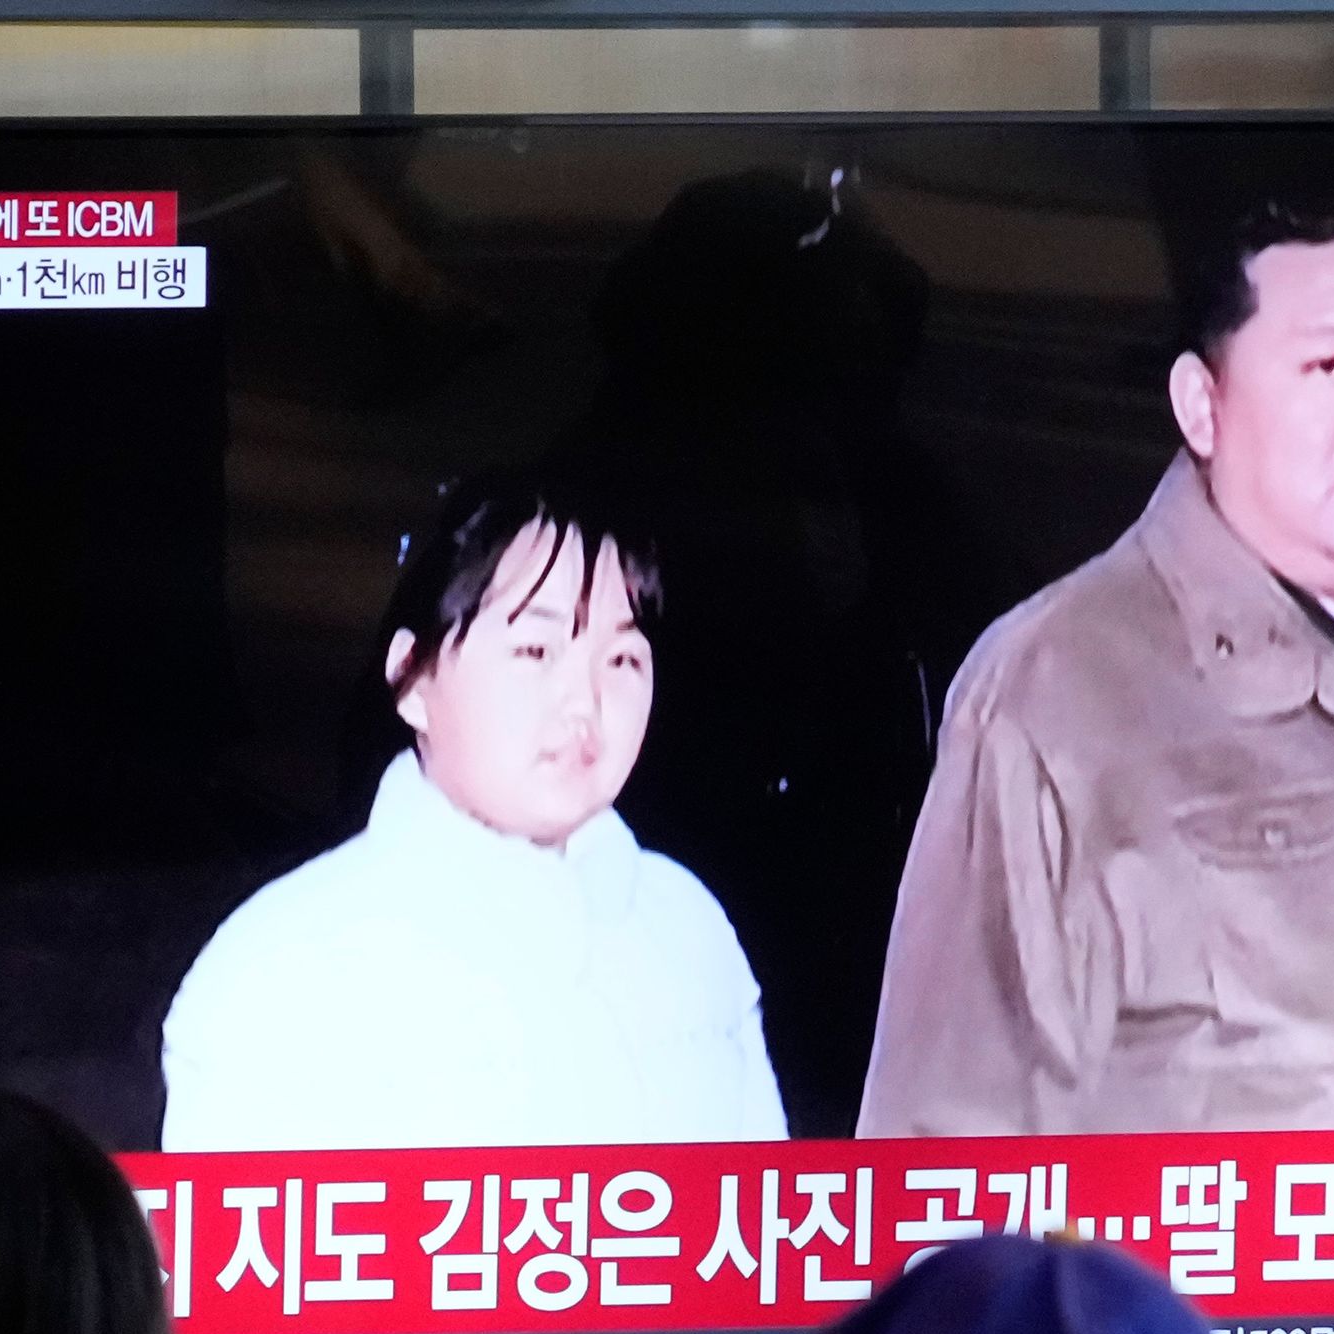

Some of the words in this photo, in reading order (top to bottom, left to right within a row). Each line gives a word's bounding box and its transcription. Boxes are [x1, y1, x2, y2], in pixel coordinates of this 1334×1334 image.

[24, 200, 62, 237] 또
[67, 200, 154, 238] ICBM
[117, 257, 187, 300] 비행
[215, 1177, 395, 1316] 지도
[417, 1170, 681, 1312] 김정은
[695, 1167, 874, 1305] 사진
